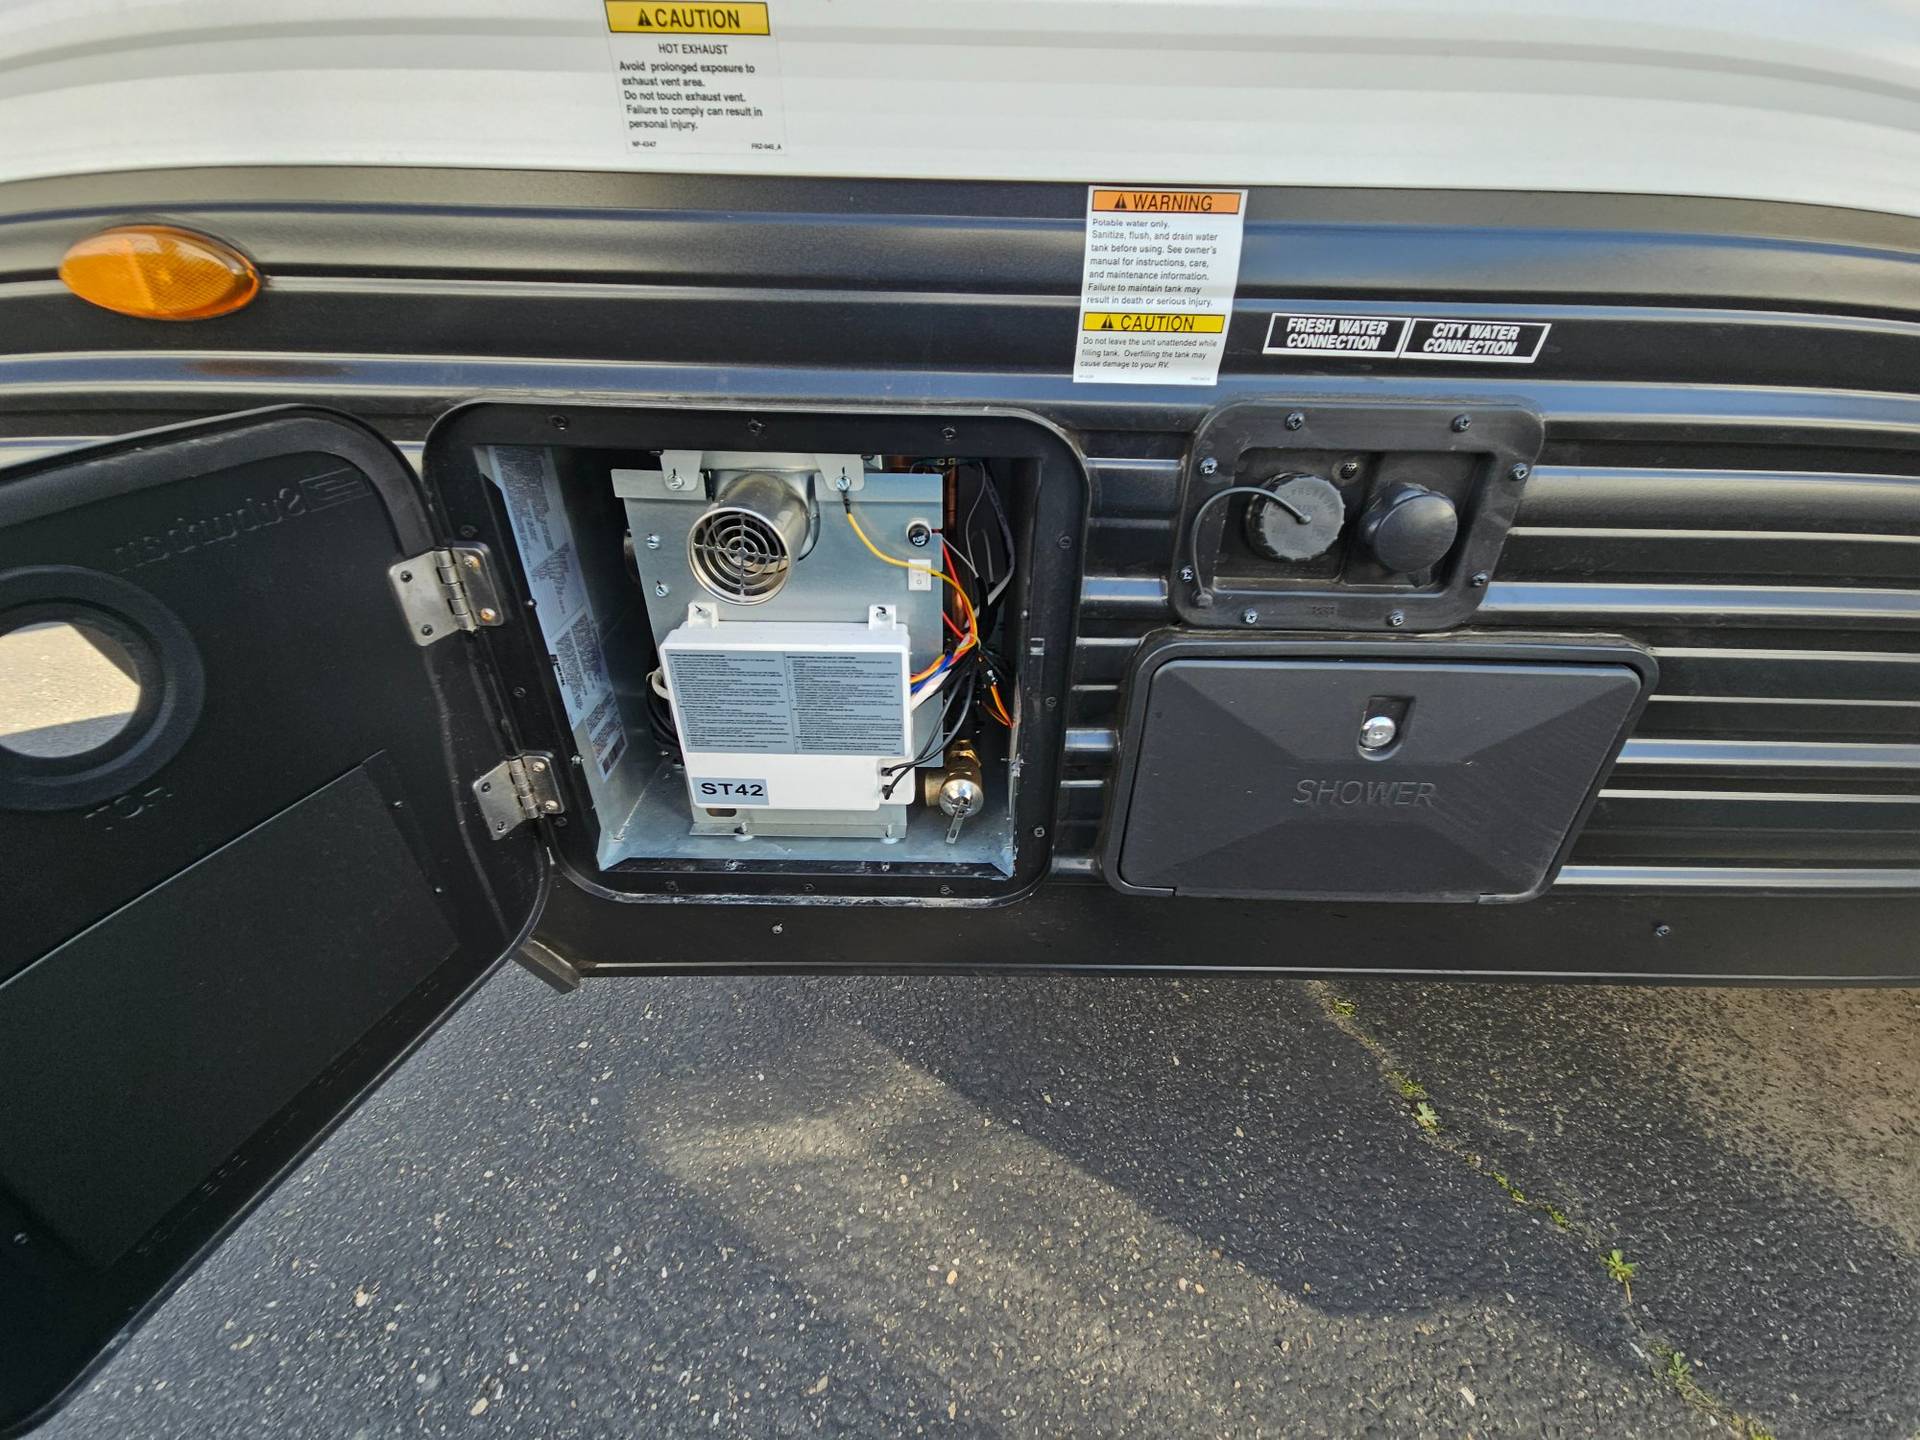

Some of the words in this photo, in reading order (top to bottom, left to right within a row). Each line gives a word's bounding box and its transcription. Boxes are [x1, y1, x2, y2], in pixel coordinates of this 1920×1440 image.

[654, 8, 740, 29] CAUTION
[658, 44, 678, 54] HOT
[682, 44, 728, 55] EXHAUST
[620, 61, 645, 71] Avoid
[651, 62, 697, 74] prolonged
[700, 64, 743, 74] exposure
[745, 65, 755, 73] to
[622, 77, 658, 86] exhaust
[683, 79, 705, 87] area.
[624, 91, 637, 100] Do
[640, 91, 654, 101] not
[656, 91, 682, 101] touch
[685, 92, 721, 102] exhaust
[723, 93, 746, 102] vent.
[627, 105, 657, 115] Failure
[660, 106, 669, 115] to
[671, 106, 703, 117] comply
[707, 108, 723, 116] can
[726, 107, 751, 116] result
[754, 107, 762, 116] in
[629, 119, 667, 130] personal
[670, 119, 698, 131] injury.
[1133, 194, 1213, 211] WARNING
[1092, 218, 1124, 227] Potable
[1126, 220, 1148, 228] water
[1150, 220, 1170, 229] only.
[1092, 231, 1126, 241] Sanitize,
[1129, 231, 1151, 241] flush,
[1154, 232, 1169, 241] and
[1172, 232, 1193, 241] drain
[1195, 233, 1218, 241] water
[1091, 244, 1108, 252] tank
[1111, 244, 1137, 253] before
[1139, 245, 1165, 256] using.
[1167, 245, 1182, 254] See
[1184, 245, 1216, 255] owner's
[1090, 257, 1120, 266] manual
[1122, 257, 1133, 266] for
[1136, 258, 1186, 268] instructions,
[1189, 260, 1209, 268] care,
[1089, 270, 1104, 279] and
[1107, 271, 1158, 280] maintenance
[1160, 271, 1209, 281] information.
[1088, 283, 1115, 292] Failure
[1118, 284, 1126, 292] to
[1128, 284, 1162, 293] maintain
[1164, 284, 1182, 293] tank
[1184, 286, 1201, 294] may
[1087, 295, 1110, 304] result
[1112, 296, 1119, 304] in
[1122, 296, 1143, 305] death
[1157, 297, 1186, 306] serious
[1188, 297, 1213, 307] injury.
[1120, 315, 1195, 331] CAUTION
[1286, 318, 1337, 333] FRESH
[1338, 319, 1388, 335] WATER
[1432, 323, 1468, 338] CITY
[1469, 324, 1520, 340] WATER
[1083, 336, 1093, 345] Do
[1095, 337, 1107, 345] not
[1129, 338, 1140, 346] the
[1141, 338, 1155, 346] unit
[1157, 338, 1197, 347] unattended
[1199, 339, 1217, 347] while
[1286, 333, 1380, 350] CONNECTION
[1423, 338, 1518, 355] CONNECTION
[1082, 349, 1101, 357] filling
[1103, 349, 1120, 357] tank.
[1124, 350, 1160, 359] Overfilling
[1161, 350, 1172, 358] the
[1175, 351, 1190, 359] tank
[1191, 352, 1206, 360] may
[1080, 360, 1100, 368] cause
[1102, 360, 1129, 369] damage
[1131, 360, 1138, 368] to
[1140, 361, 1156, 370] your
[1158, 361, 1169, 369] RV.
[701, 782, 764, 796] ST42
[1292, 779, 1437, 807] SHOWER
